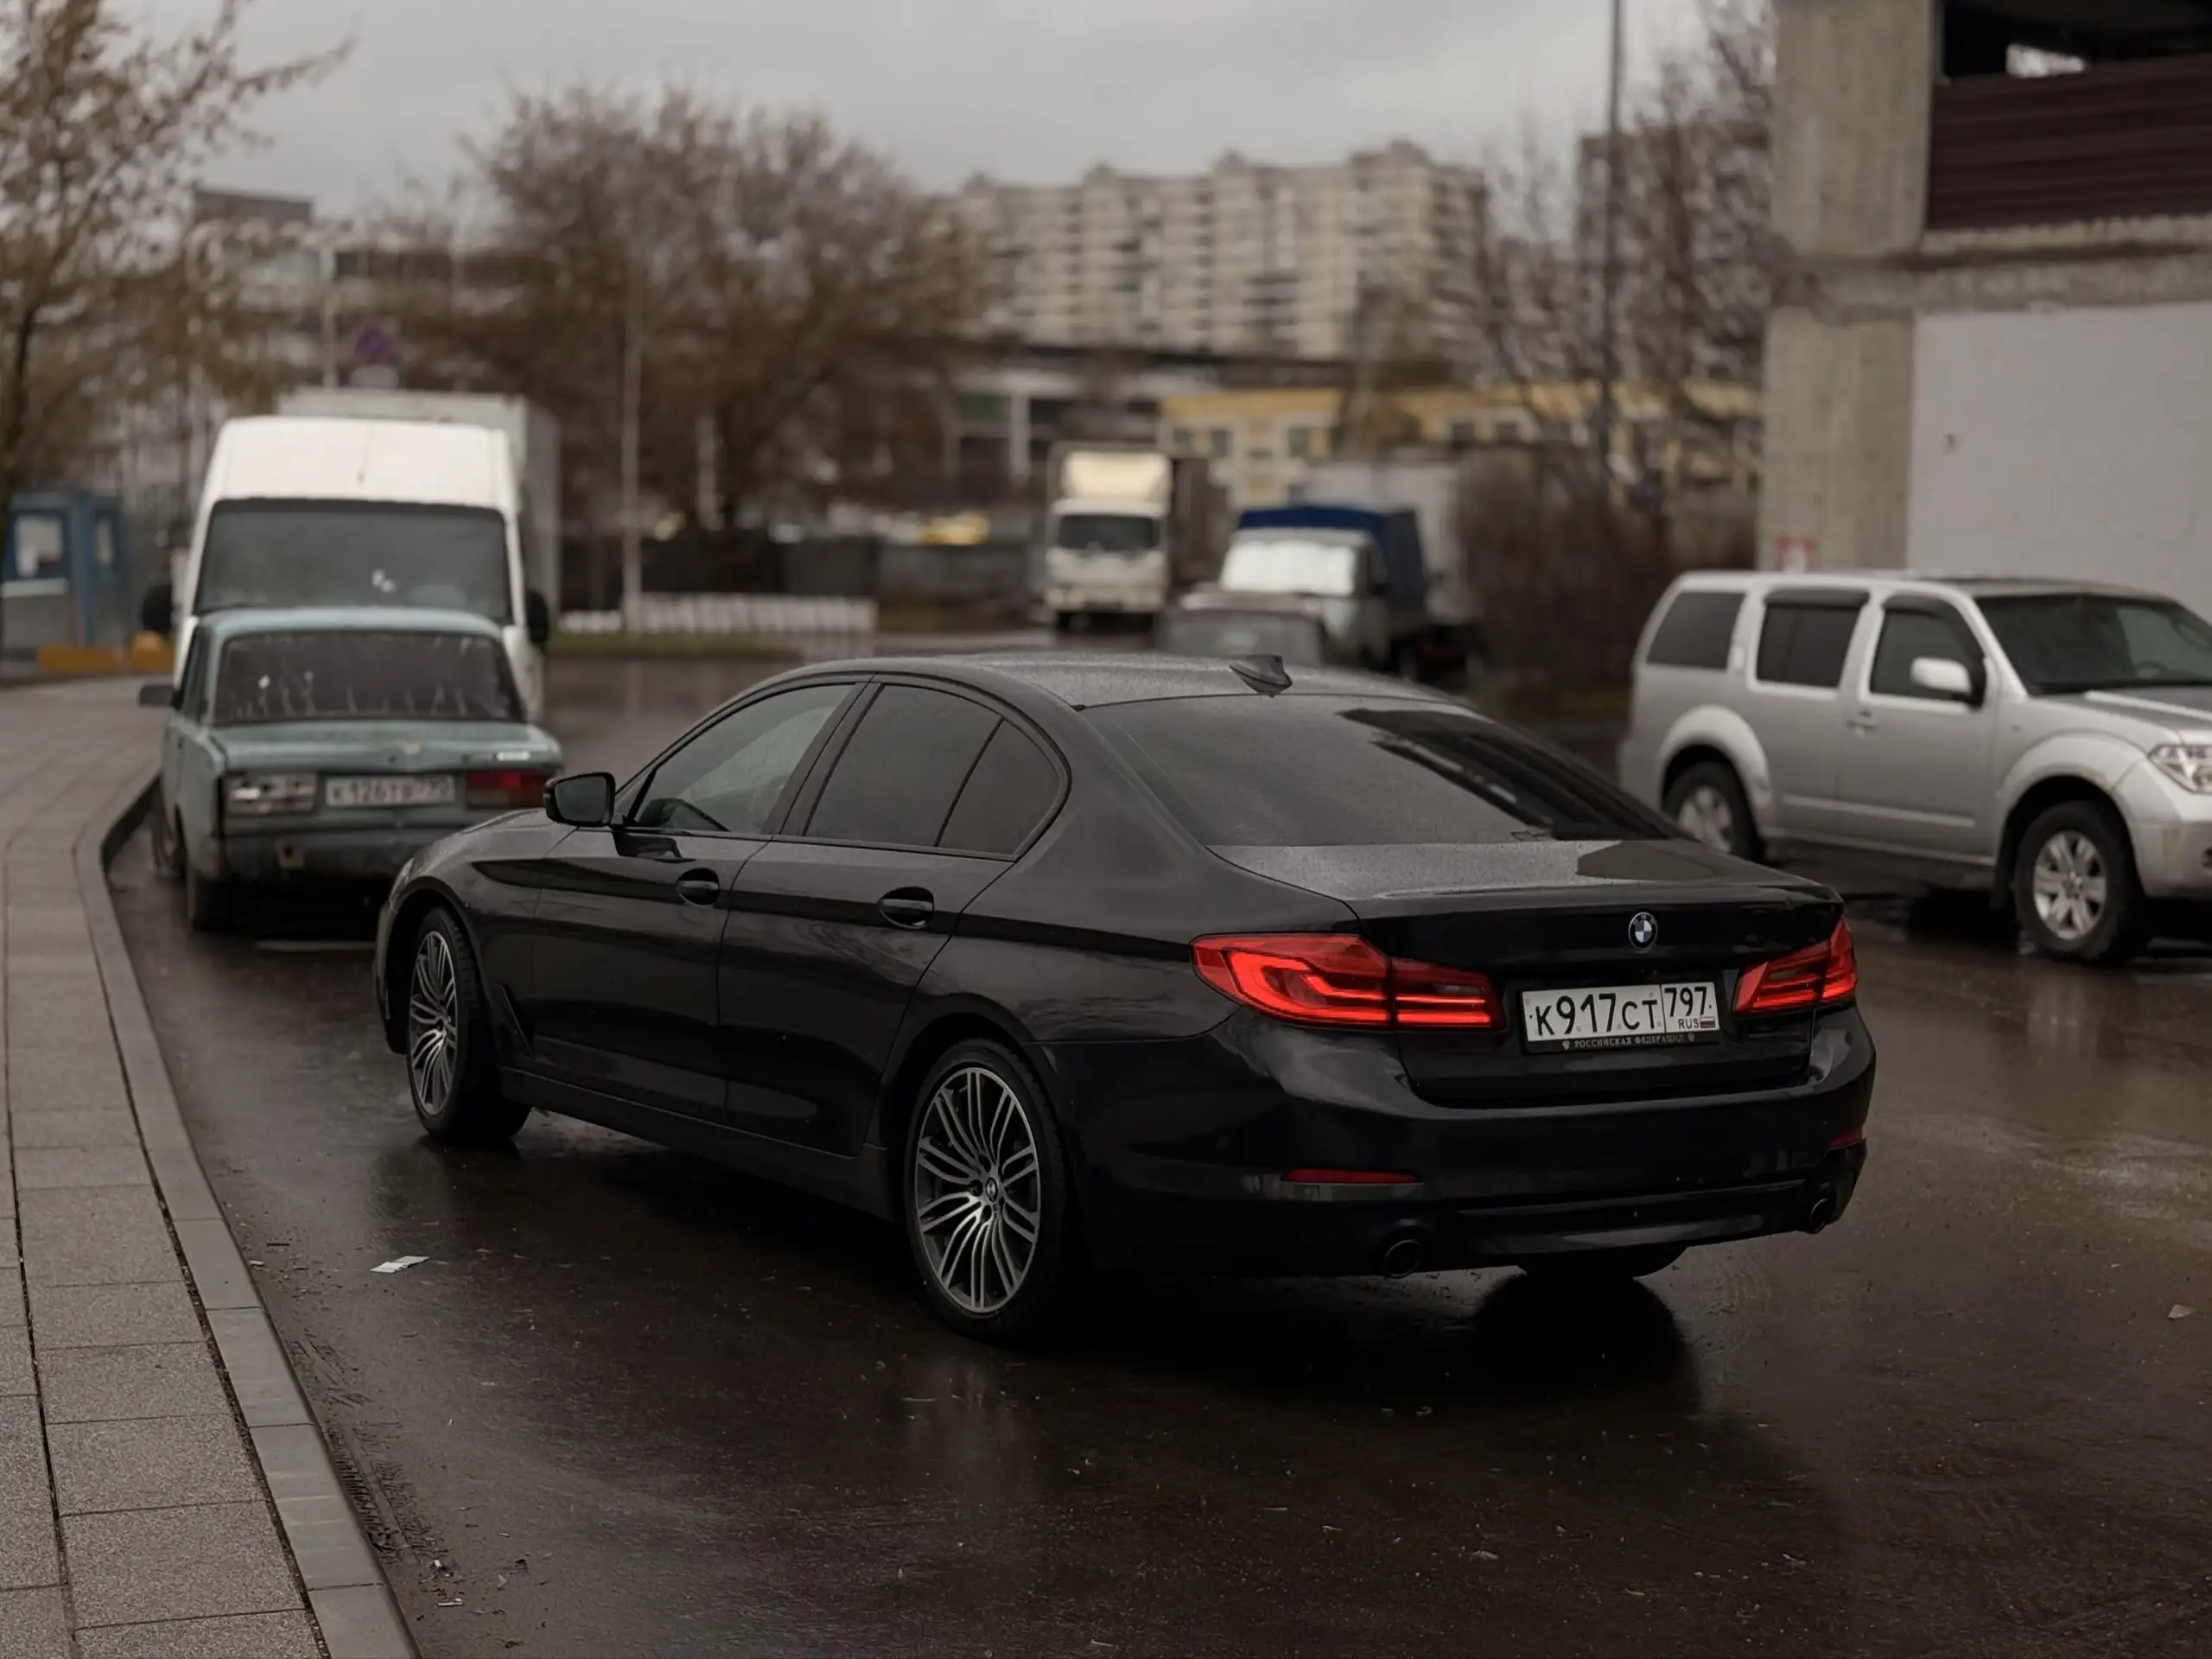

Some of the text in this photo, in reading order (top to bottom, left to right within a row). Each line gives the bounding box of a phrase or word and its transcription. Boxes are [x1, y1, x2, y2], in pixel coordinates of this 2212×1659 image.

[1664, 986, 1707, 1018] 797
[1678, 1018, 1700, 1030] RUS
[1574, 1036, 1632, 1048] РОССИЙСКАЯ
